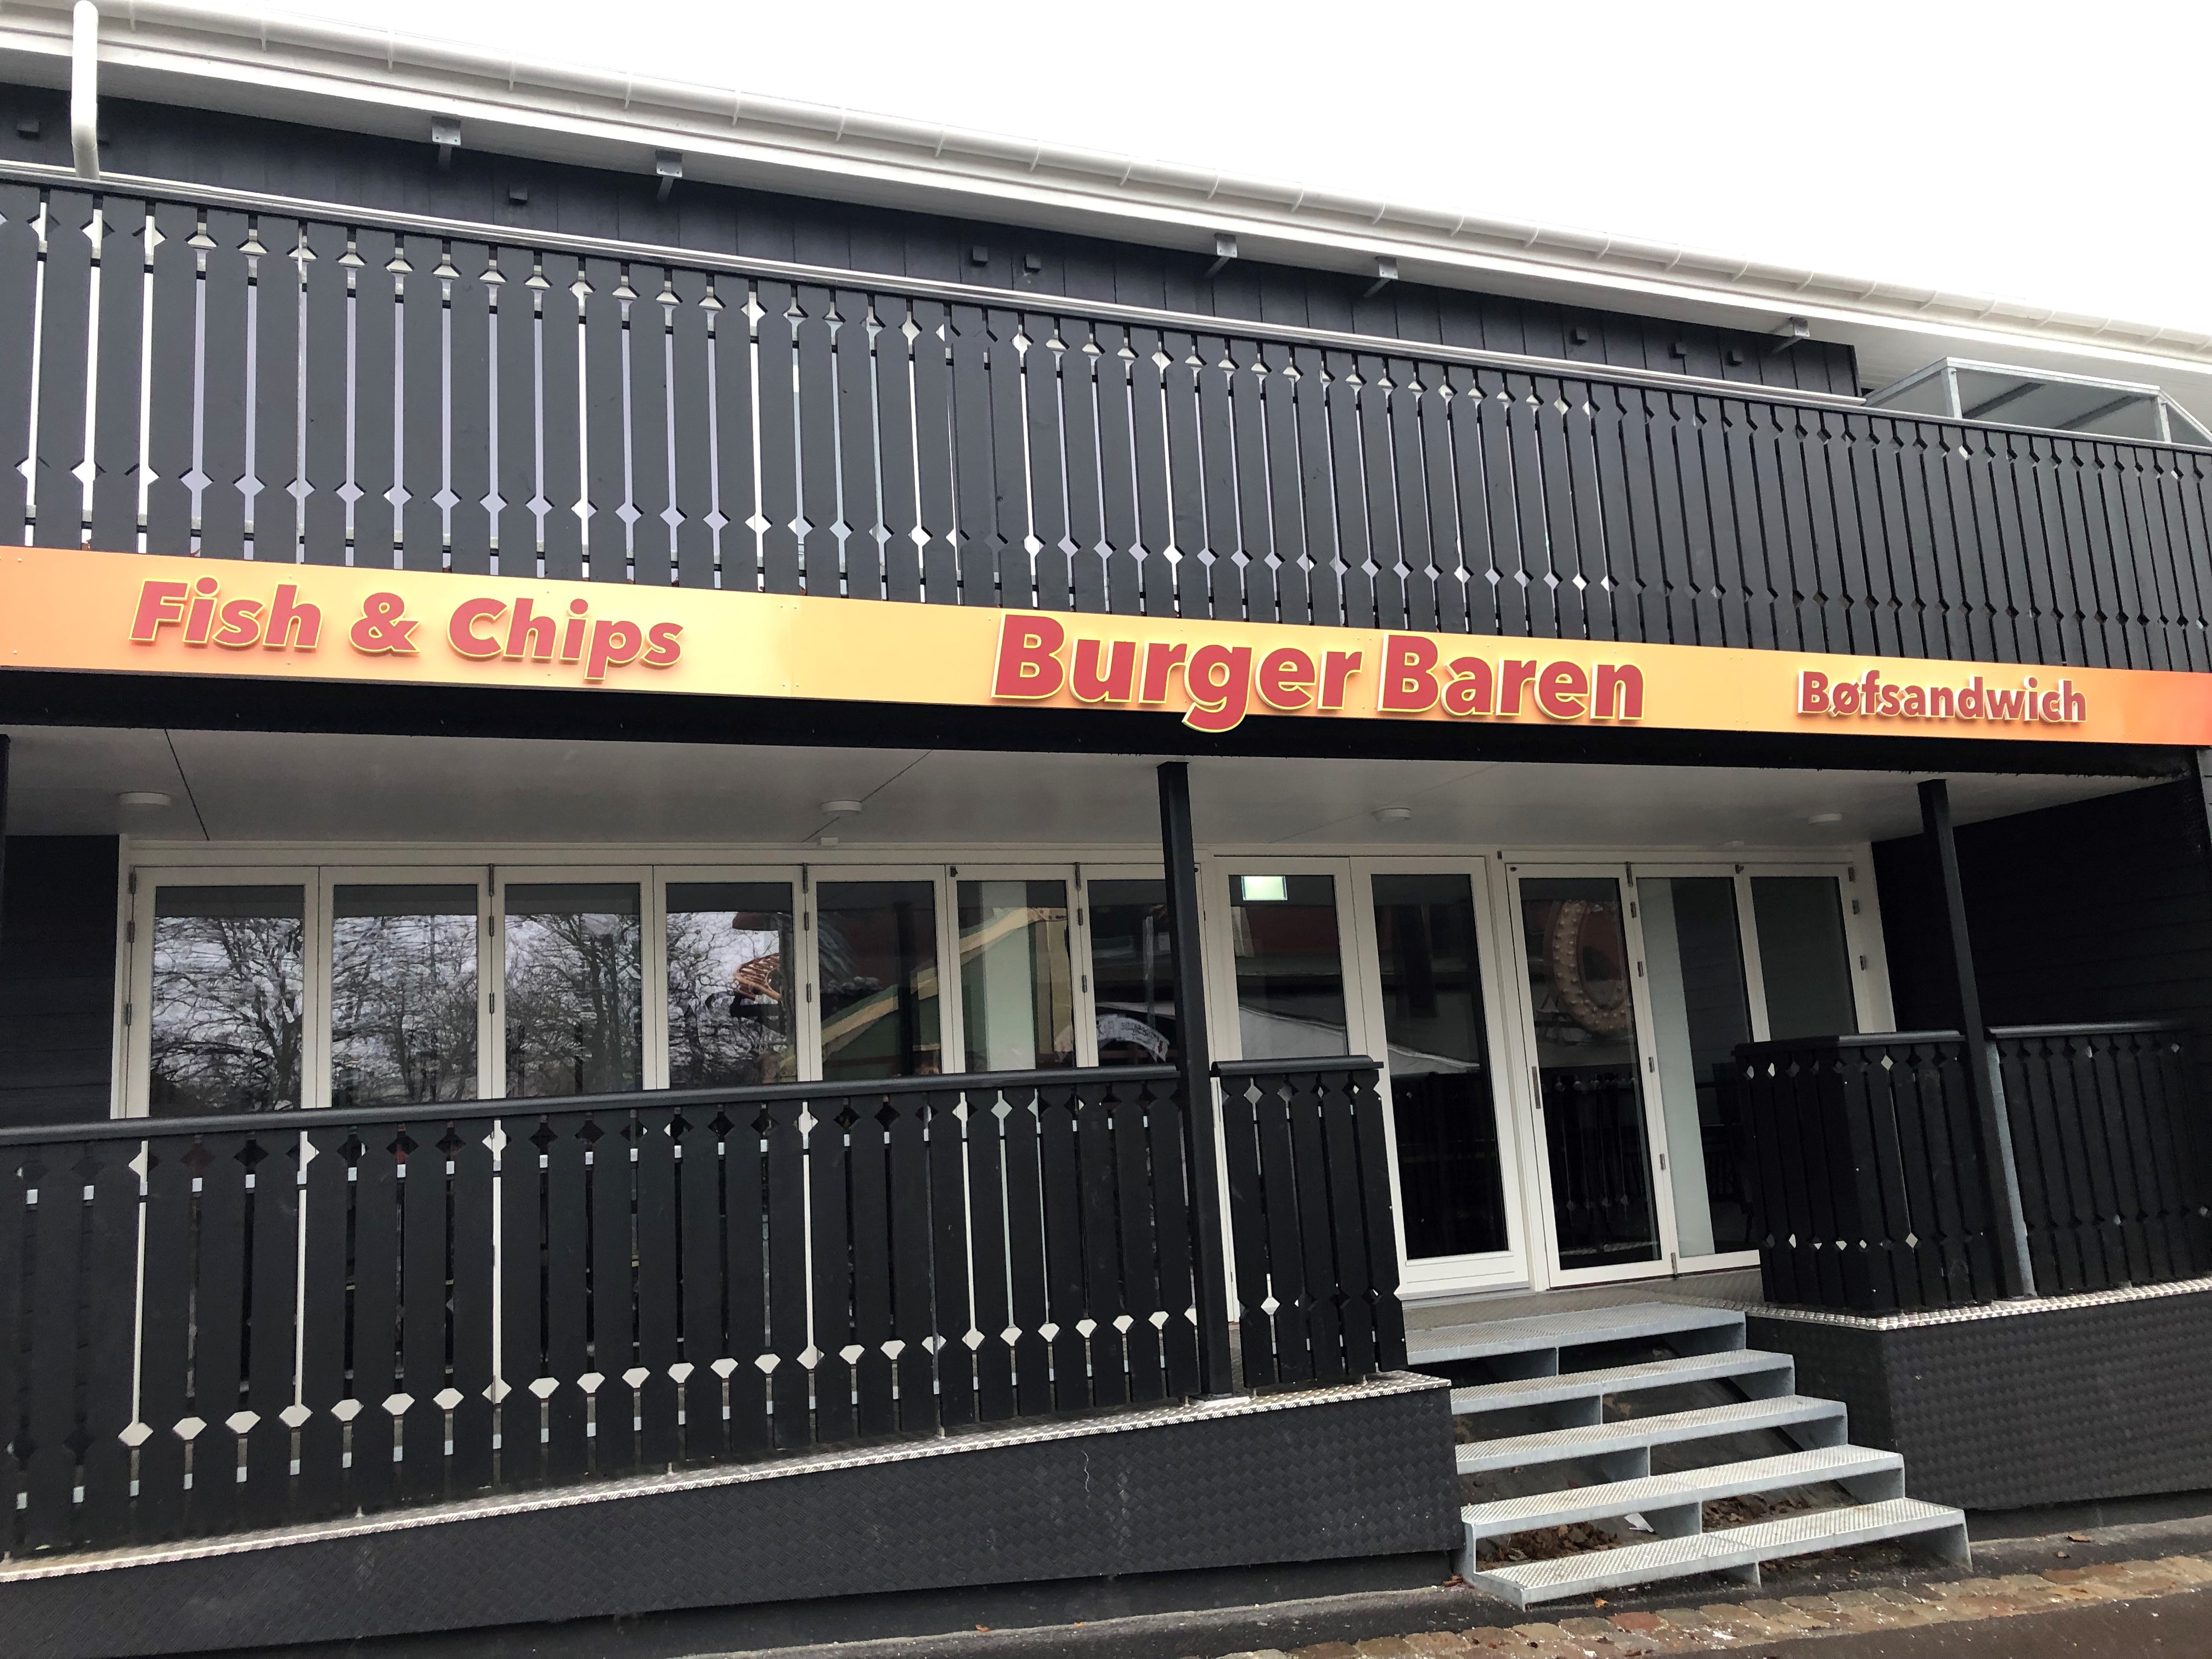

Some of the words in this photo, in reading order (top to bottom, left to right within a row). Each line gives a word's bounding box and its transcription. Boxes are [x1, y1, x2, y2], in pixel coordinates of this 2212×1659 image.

[129, 577, 323, 648] Fish
[349, 591, 420, 653] &
[448, 597, 684, 681] Chips
[991, 613, 1363, 733] Burger
[1378, 633, 1644, 720] Baren
[1798, 669, 2087, 723] Bøfsandwich
